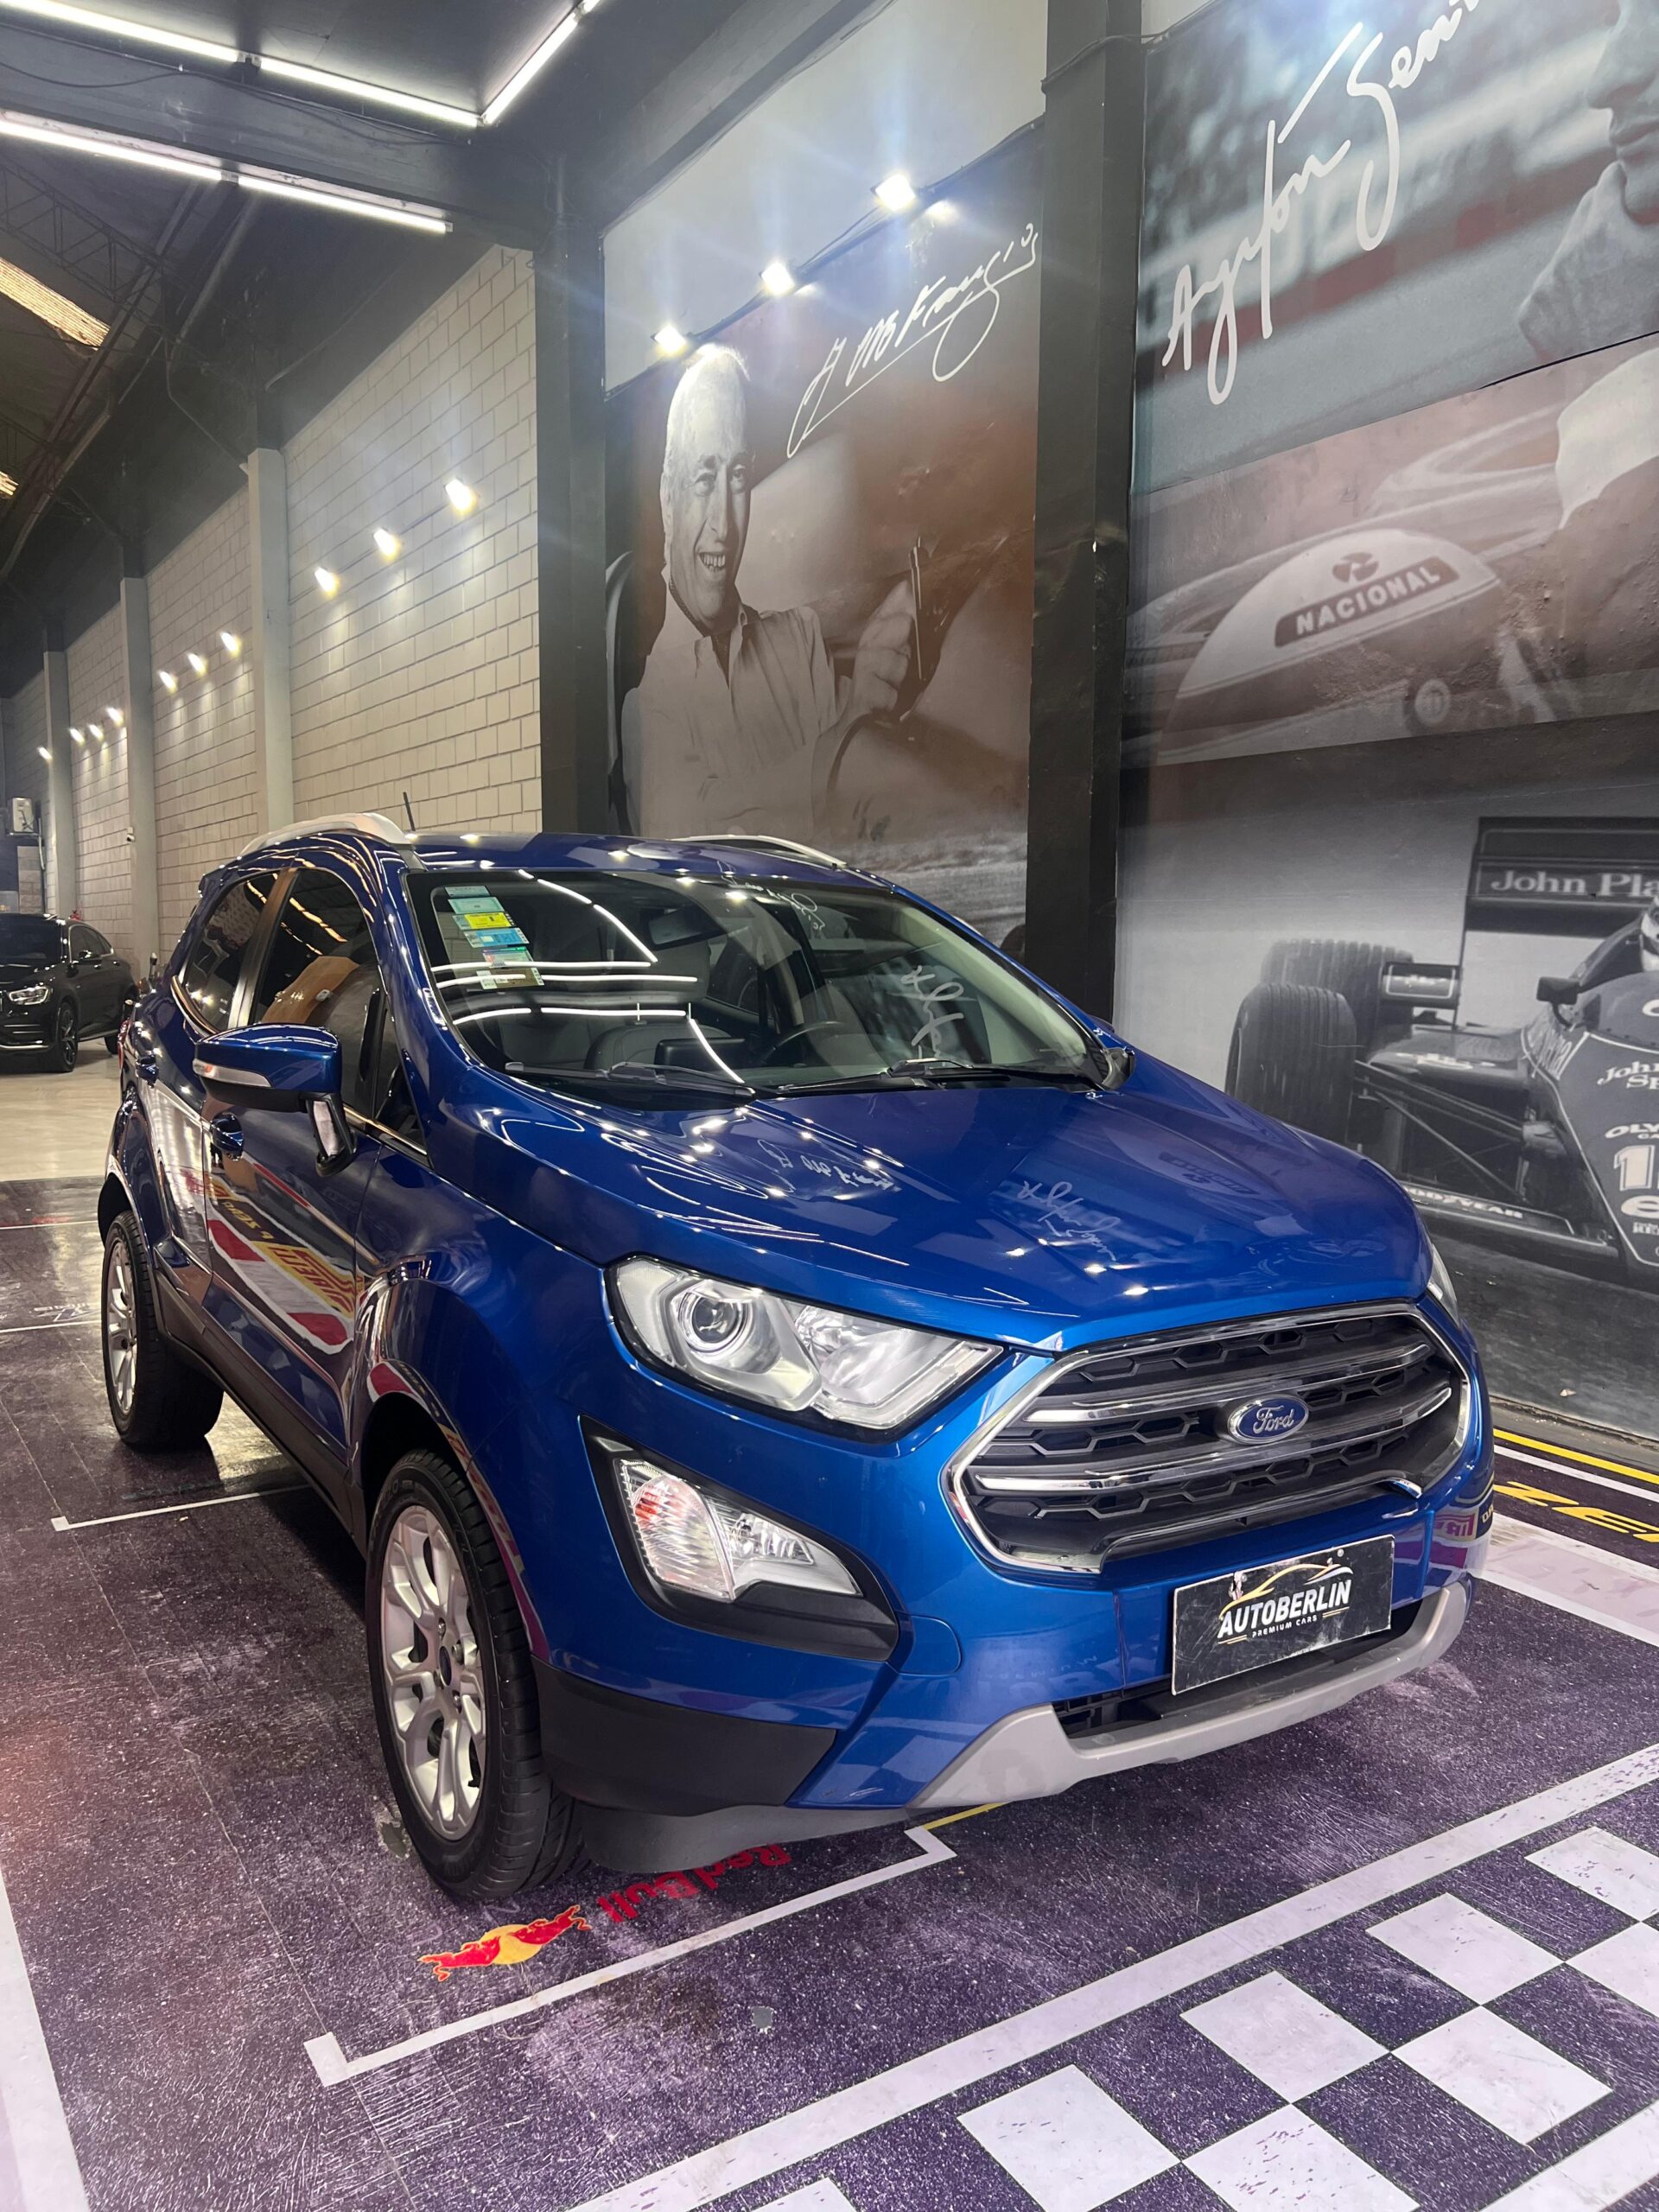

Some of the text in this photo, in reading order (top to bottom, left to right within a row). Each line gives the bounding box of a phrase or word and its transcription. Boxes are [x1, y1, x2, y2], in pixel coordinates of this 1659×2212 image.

[1295, 564, 1441, 636] NACIONAL
[1491, 869, 1589, 896] John
[1613, 1145, 1659, 1192] 1
[1252, 1405, 1294, 1434] Ford
[1217, 1579, 1352, 1639] AUTOBERLIN
[1251, 1614, 1318, 1637] PREMIUM CARS
[596, 1870, 701, 1923] Bull
